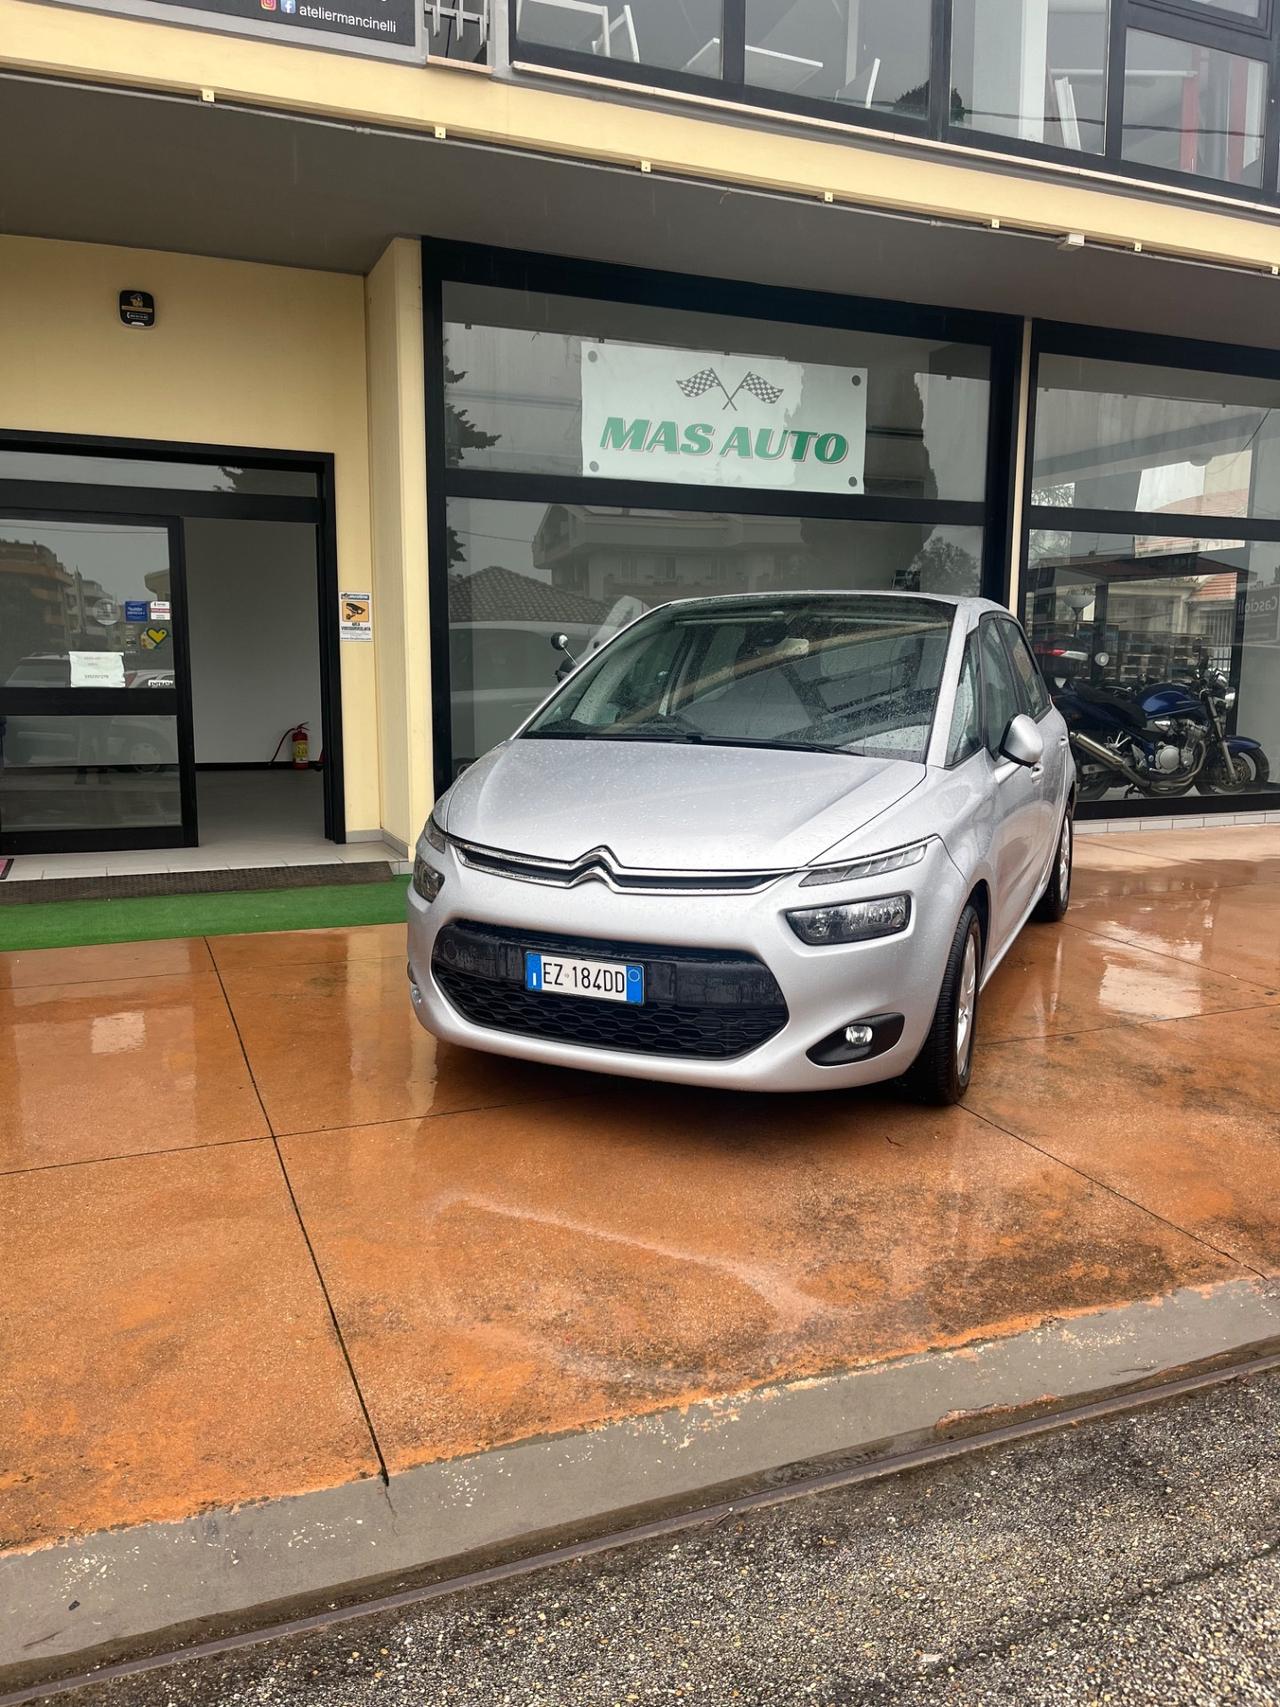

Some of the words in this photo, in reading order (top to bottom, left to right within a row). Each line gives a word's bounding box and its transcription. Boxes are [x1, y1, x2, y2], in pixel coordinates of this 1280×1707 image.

[299, 4, 396, 33] ateliermancinelli
[600, 417, 715, 455] MAS
[719, 426, 849, 465] AUTO
